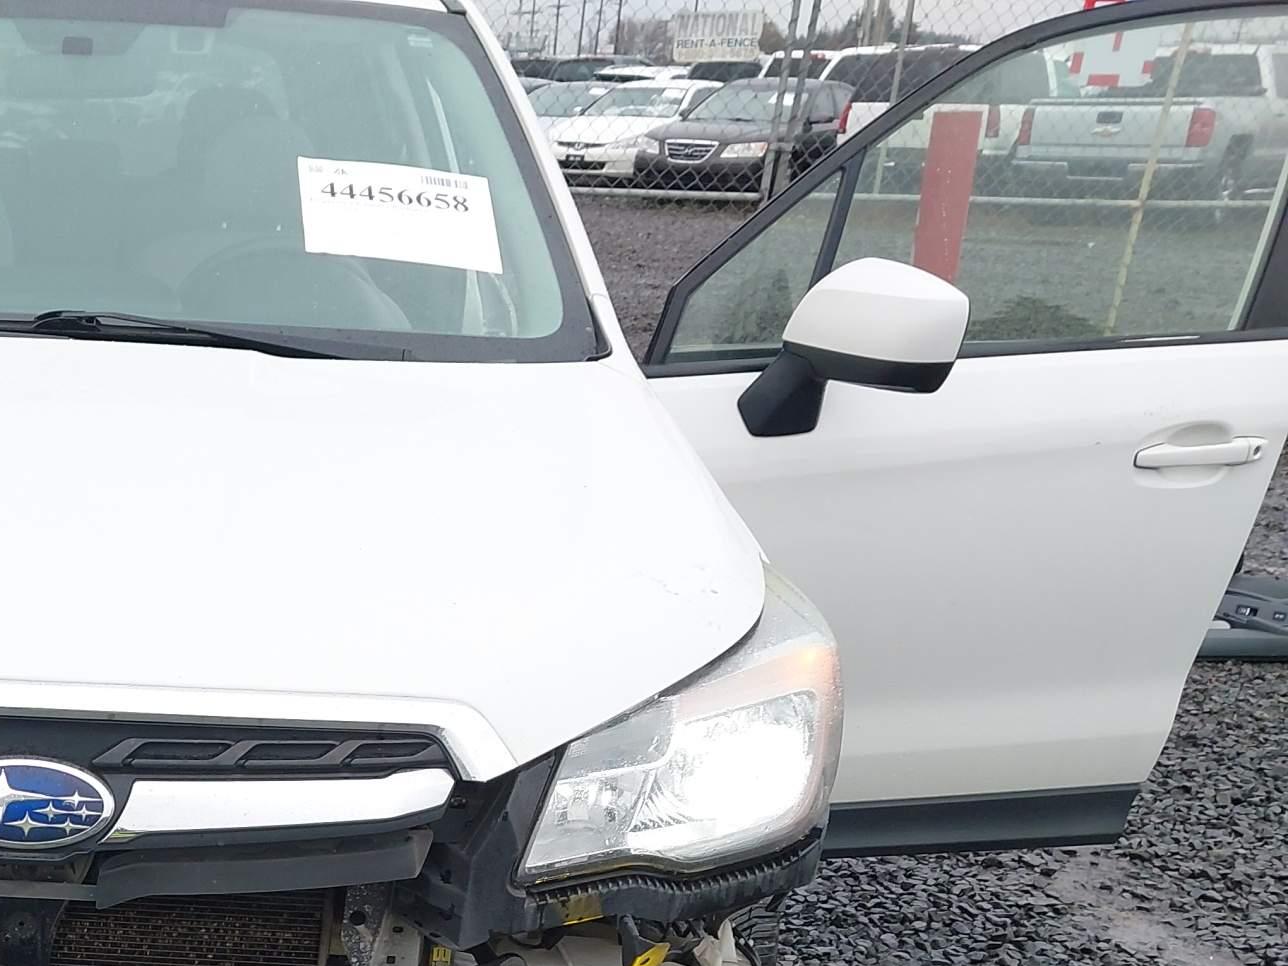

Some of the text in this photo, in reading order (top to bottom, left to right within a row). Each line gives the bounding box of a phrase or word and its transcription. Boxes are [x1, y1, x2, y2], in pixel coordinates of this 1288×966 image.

[678, 12, 759, 37] NATIONAL
[676, 37, 758, 48] RENT-A-FENCE
[320, 181, 469, 212] 44456658
